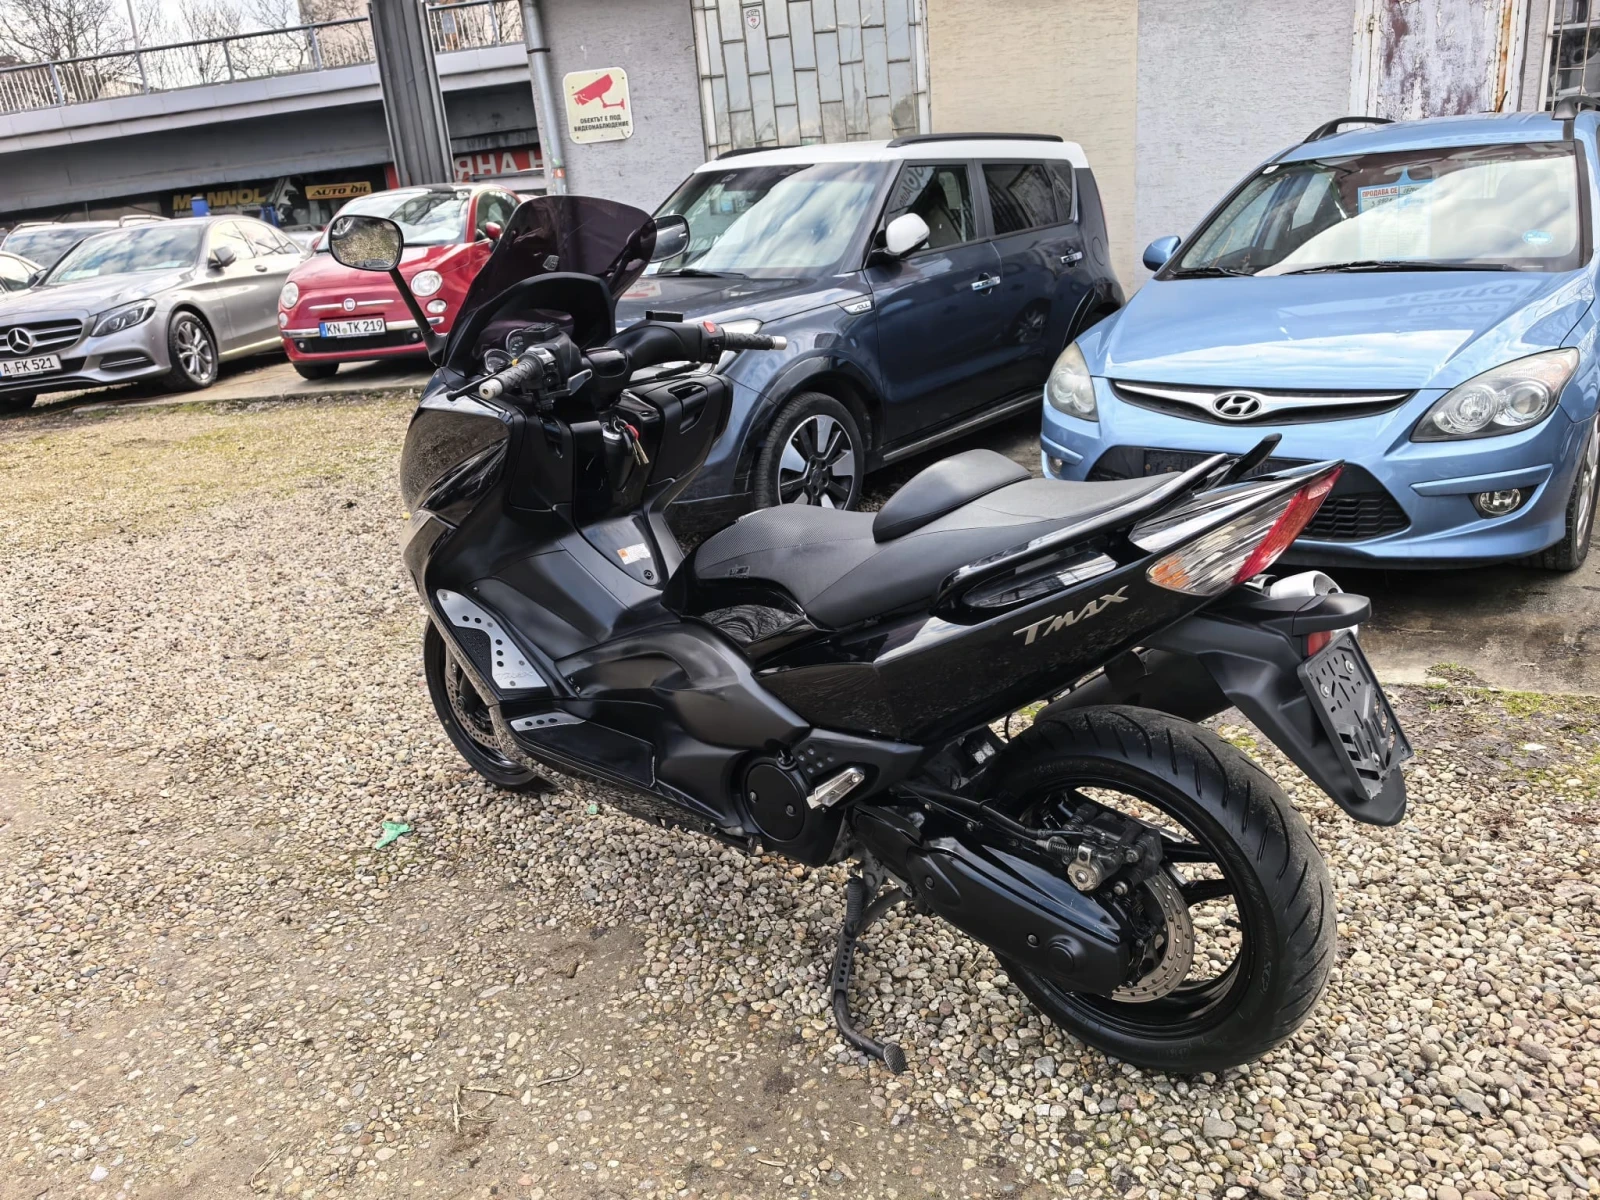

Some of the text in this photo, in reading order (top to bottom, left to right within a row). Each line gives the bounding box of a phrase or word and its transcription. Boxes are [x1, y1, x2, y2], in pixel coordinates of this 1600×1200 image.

[573, 120, 629, 132] ВИДЕОНАБЛЮДЕНИЕ
[580, 116, 603, 124] ОБЕКТЪТ
[312, 187, 346, 196] AUTO
[1361, 189, 1389, 198] ПРОДАВА
[1390, 187, 1398, 195] СЕ
[172, 188, 266, 212] MNNOL
[326, 319, 383, 336] KN TK 219
[3, 357, 55, 375] A FK 521
[1012, 585, 1129, 646] TMAX
